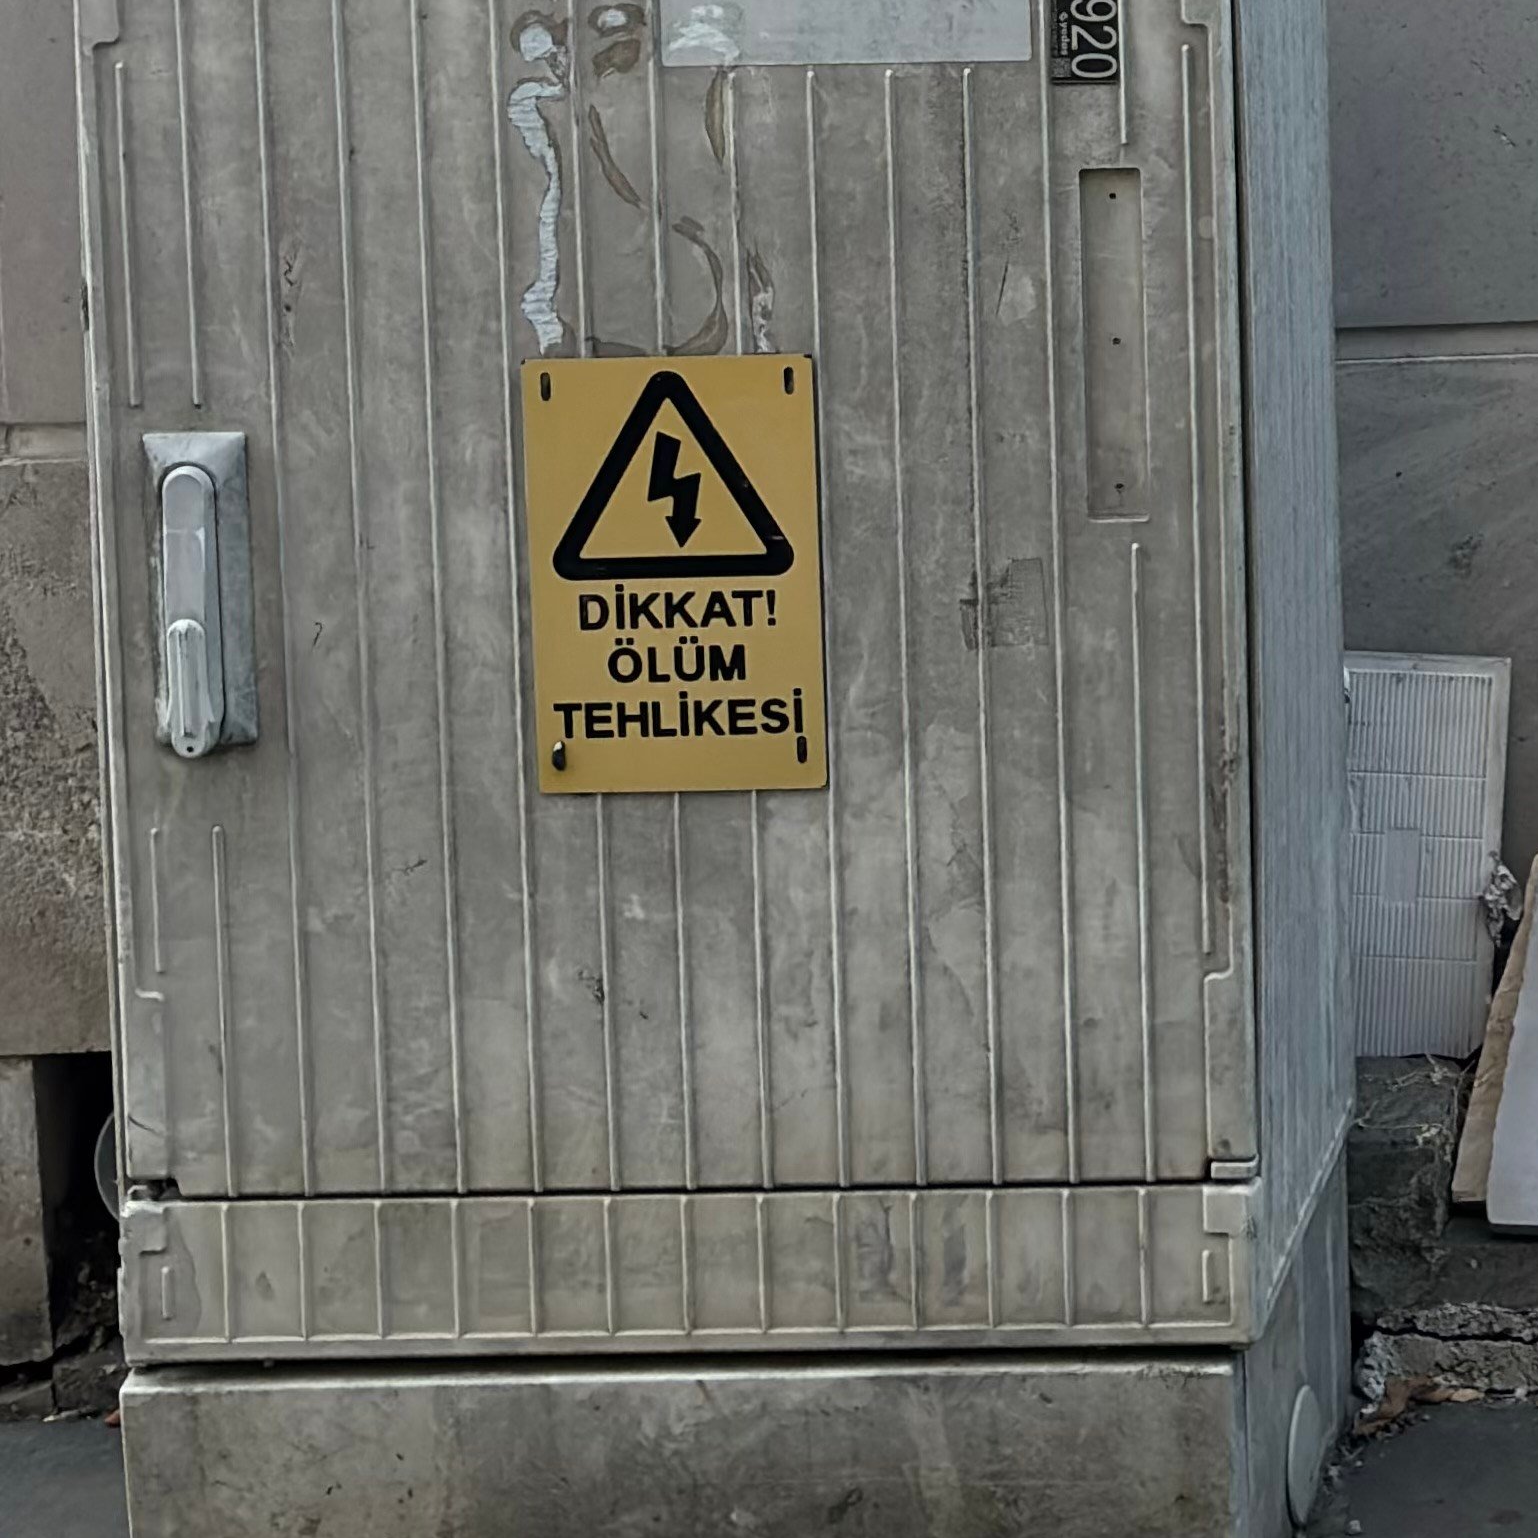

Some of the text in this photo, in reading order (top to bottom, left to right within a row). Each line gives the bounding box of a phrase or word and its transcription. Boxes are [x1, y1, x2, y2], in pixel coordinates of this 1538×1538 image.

[579, 584, 777, 630] DİKKAT!
[607, 636, 747, 683] ÖLÜM
[553, 687, 804, 739] TEHLİKESİ
